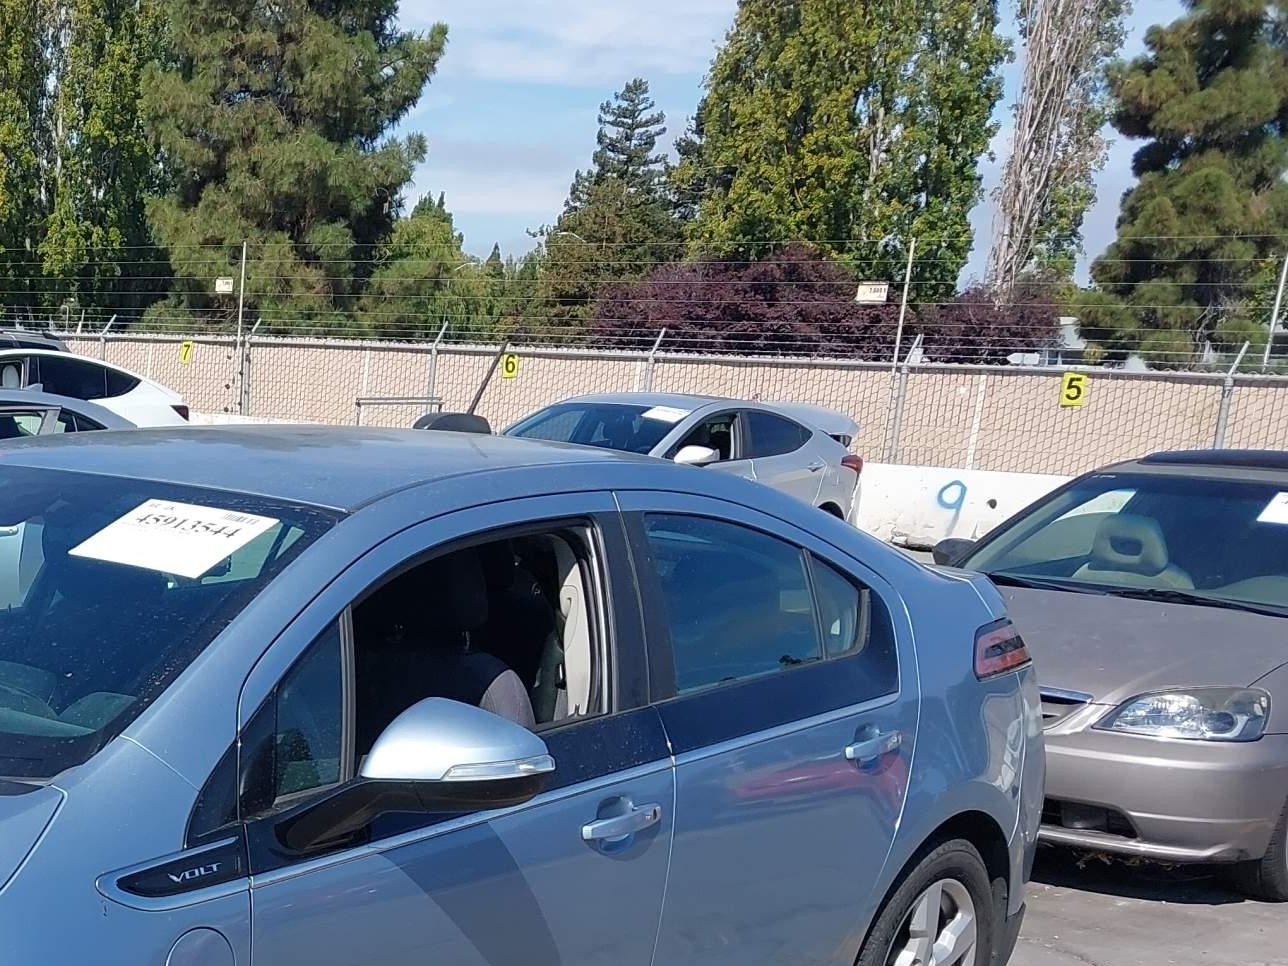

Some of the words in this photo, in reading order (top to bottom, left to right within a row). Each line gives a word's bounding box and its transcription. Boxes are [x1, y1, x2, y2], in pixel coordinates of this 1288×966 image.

[183, 343, 191, 361] 7
[505, 354, 516, 374] 6
[1065, 377, 1083, 401] 5
[937, 480, 967, 537] 9
[136, 513, 243, 539] 45913544
[167, 862, 223, 883] VOLT
